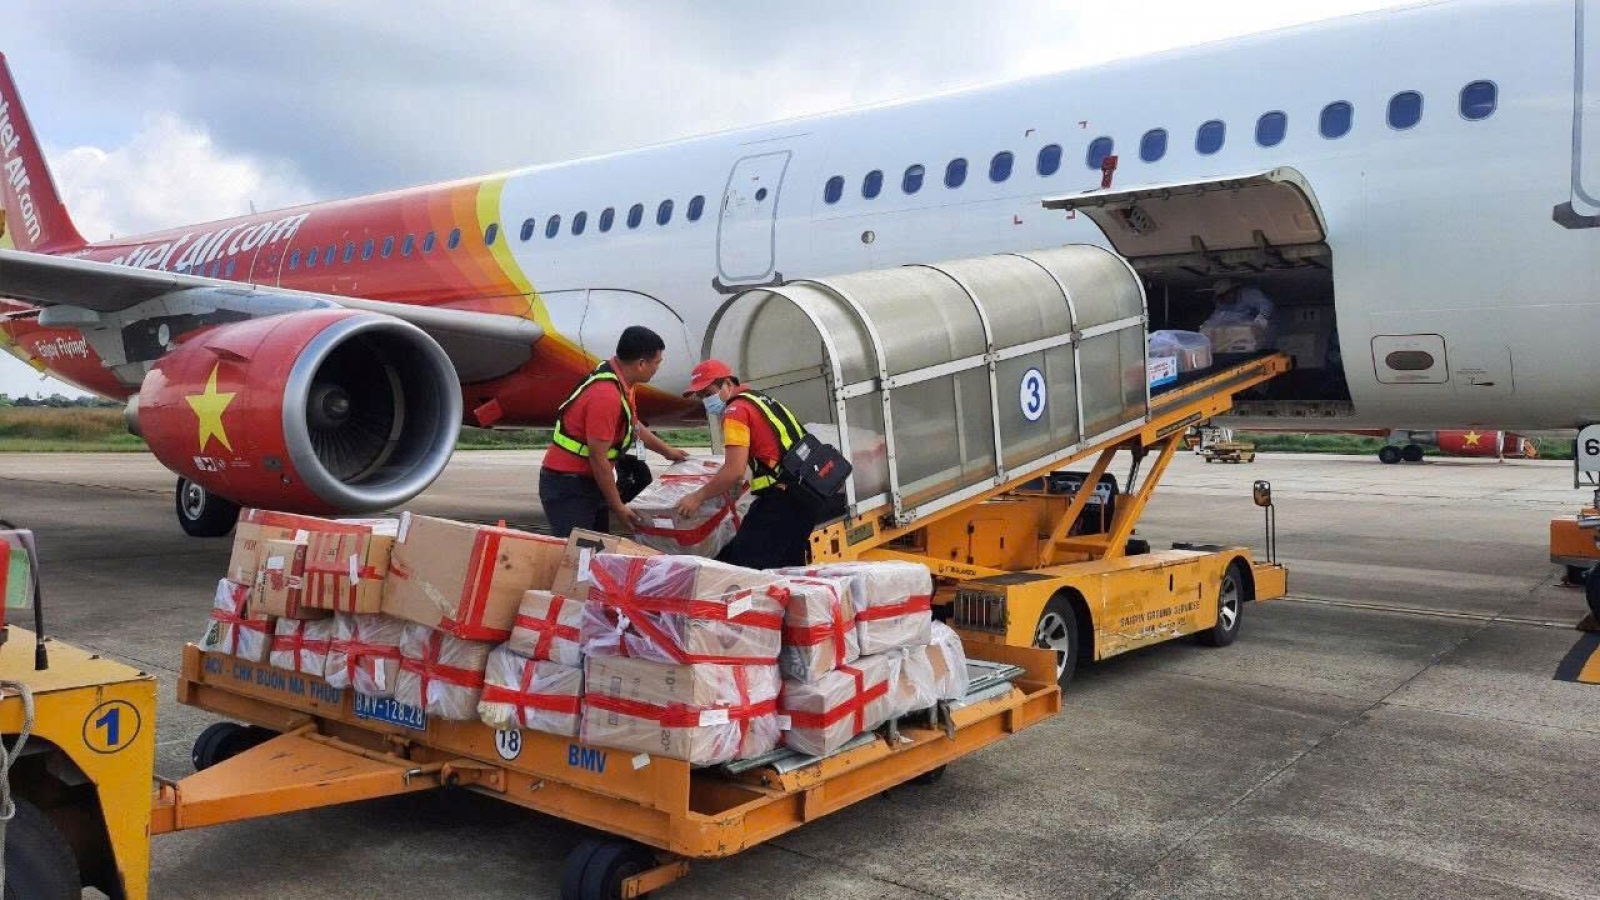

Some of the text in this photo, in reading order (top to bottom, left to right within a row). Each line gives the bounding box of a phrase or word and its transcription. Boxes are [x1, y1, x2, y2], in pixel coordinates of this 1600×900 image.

[4, 156, 41, 244] Air.com
[56, 334, 89, 358] Flying!
[1027, 376, 1041, 413] 3
[1173, 600, 1201, 615] SERVICES
[95, 707, 120, 746] 1
[499, 730, 519, 752] 18
[568, 744, 608, 773] BMV
